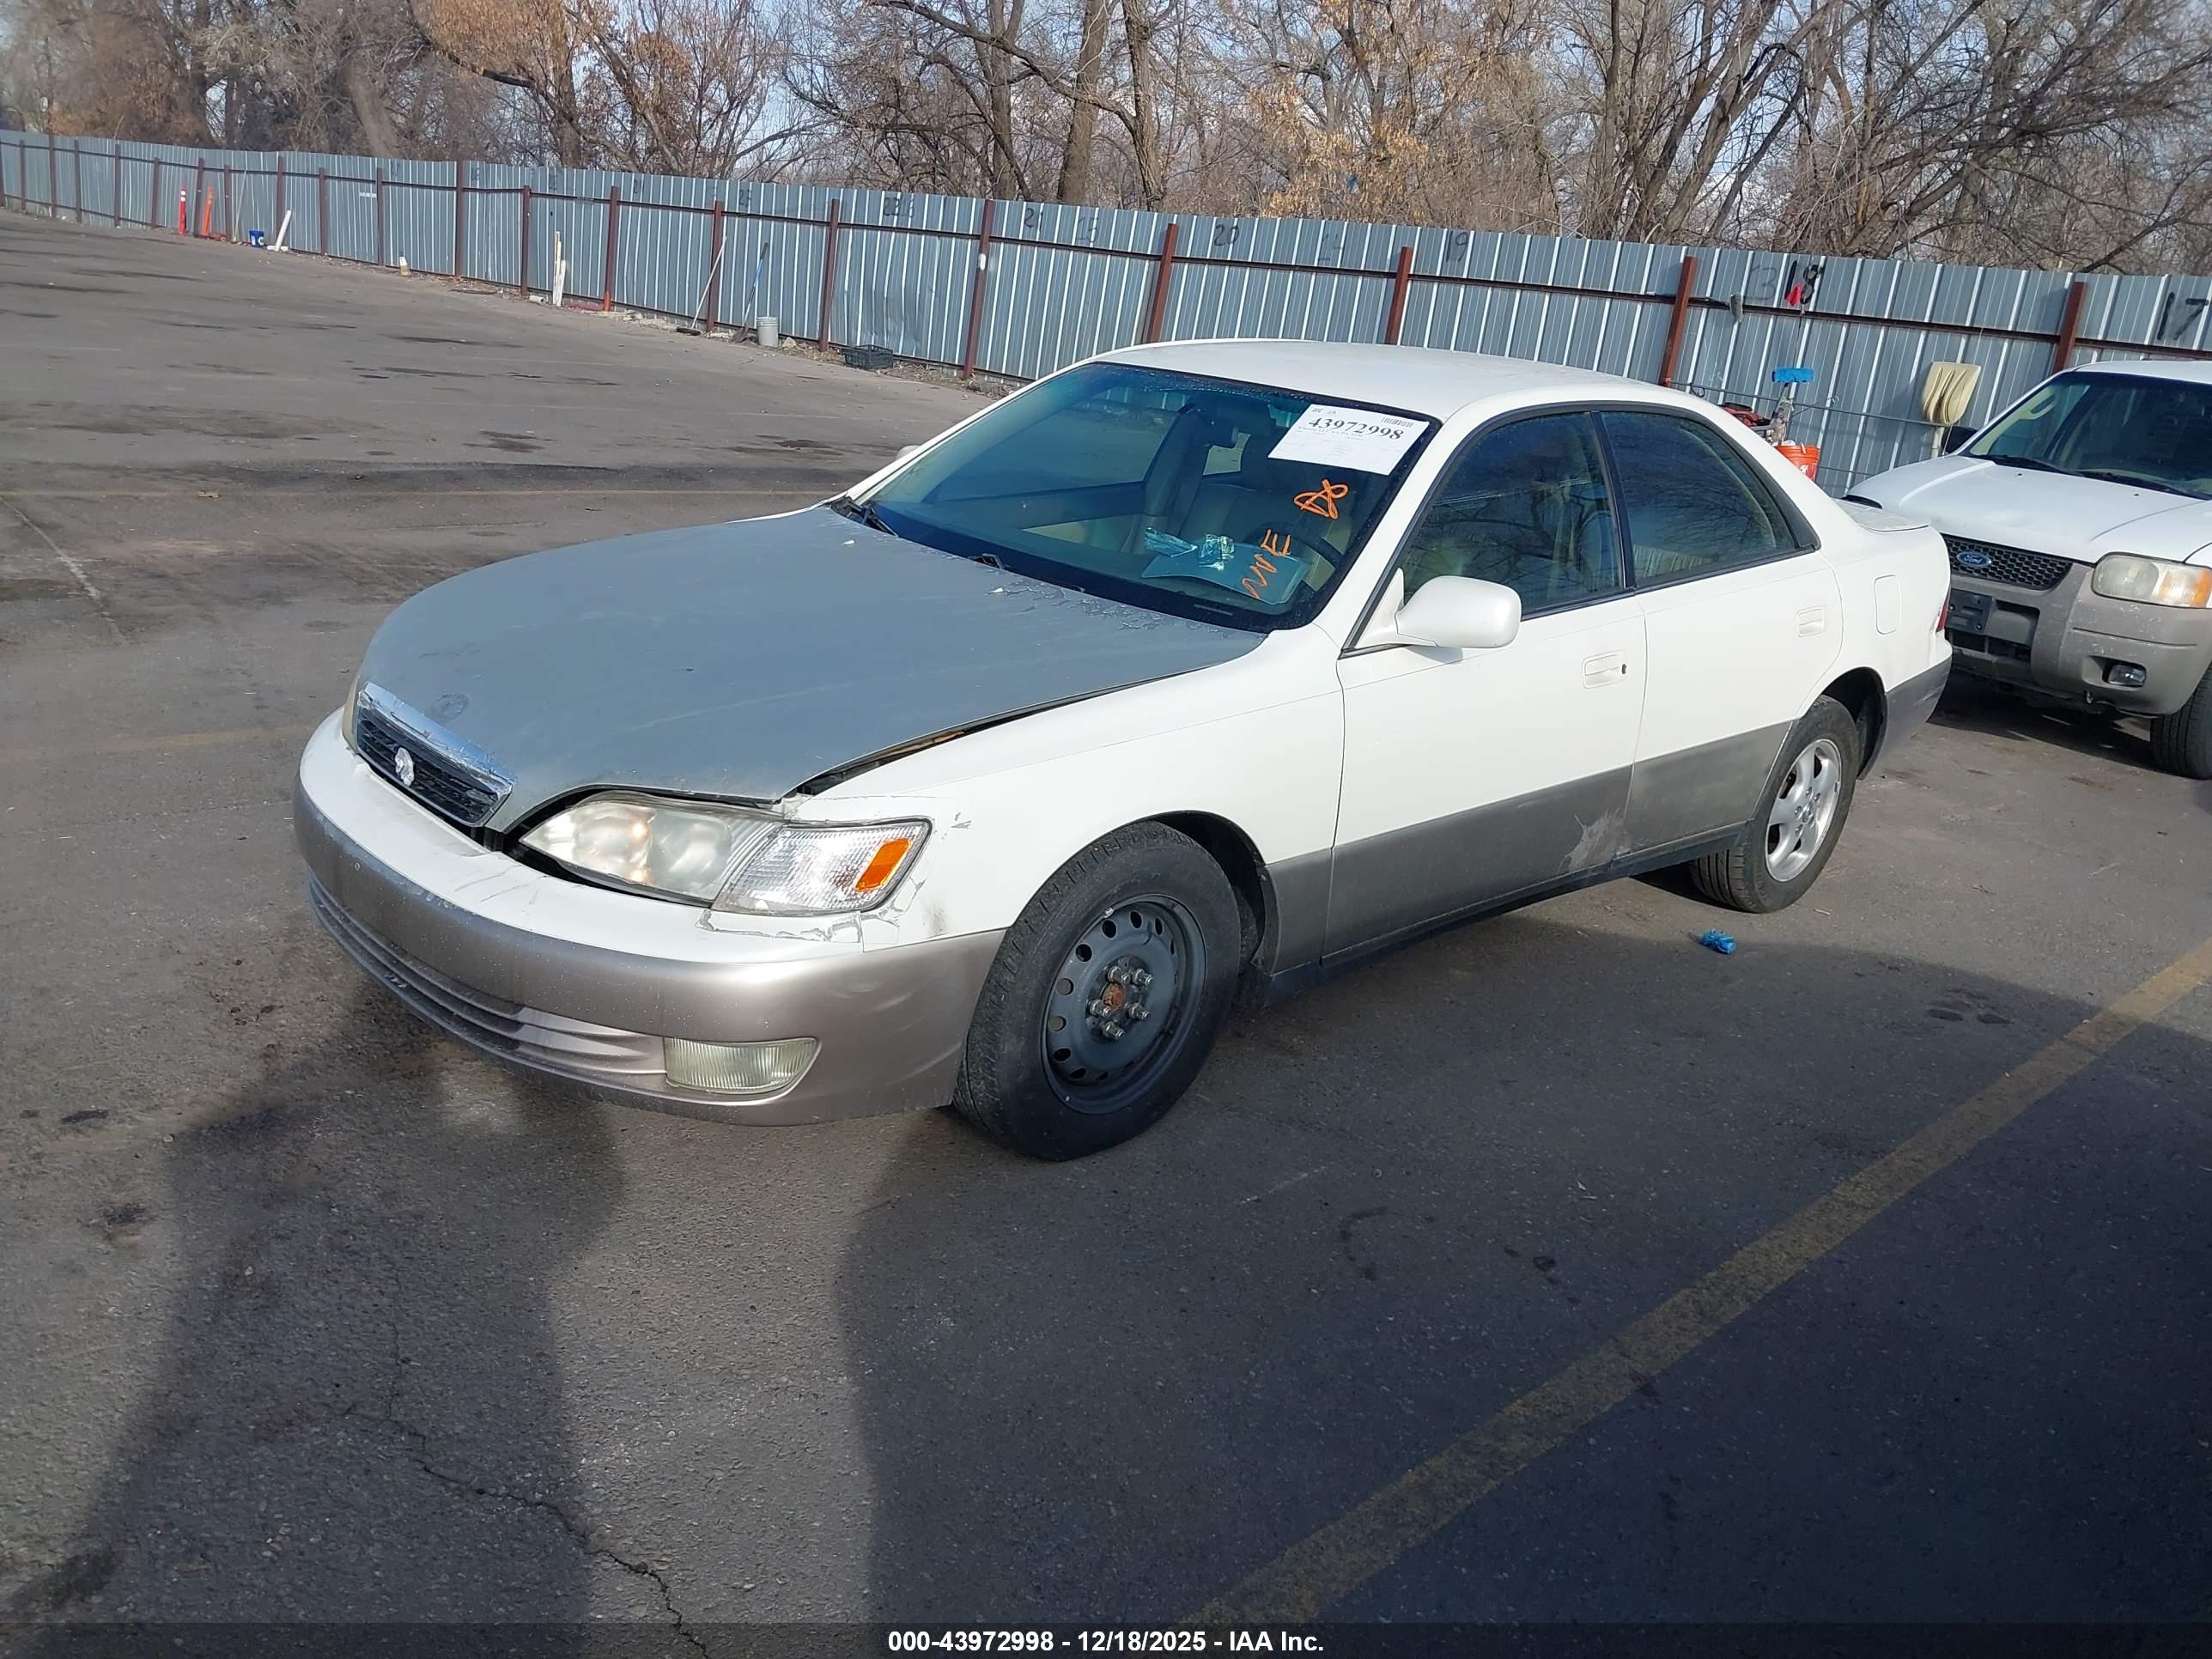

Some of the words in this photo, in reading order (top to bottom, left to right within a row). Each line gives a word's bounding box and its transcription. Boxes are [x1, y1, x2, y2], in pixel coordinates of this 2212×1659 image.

[1024, 208, 1043, 234] 21
[1214, 224, 1239, 246] 20
[1446, 231, 1468, 262] 19
[1784, 259, 1826, 305] 18
[2157, 292, 2209, 340] 17
[1308, 417, 1404, 440] 43972998
